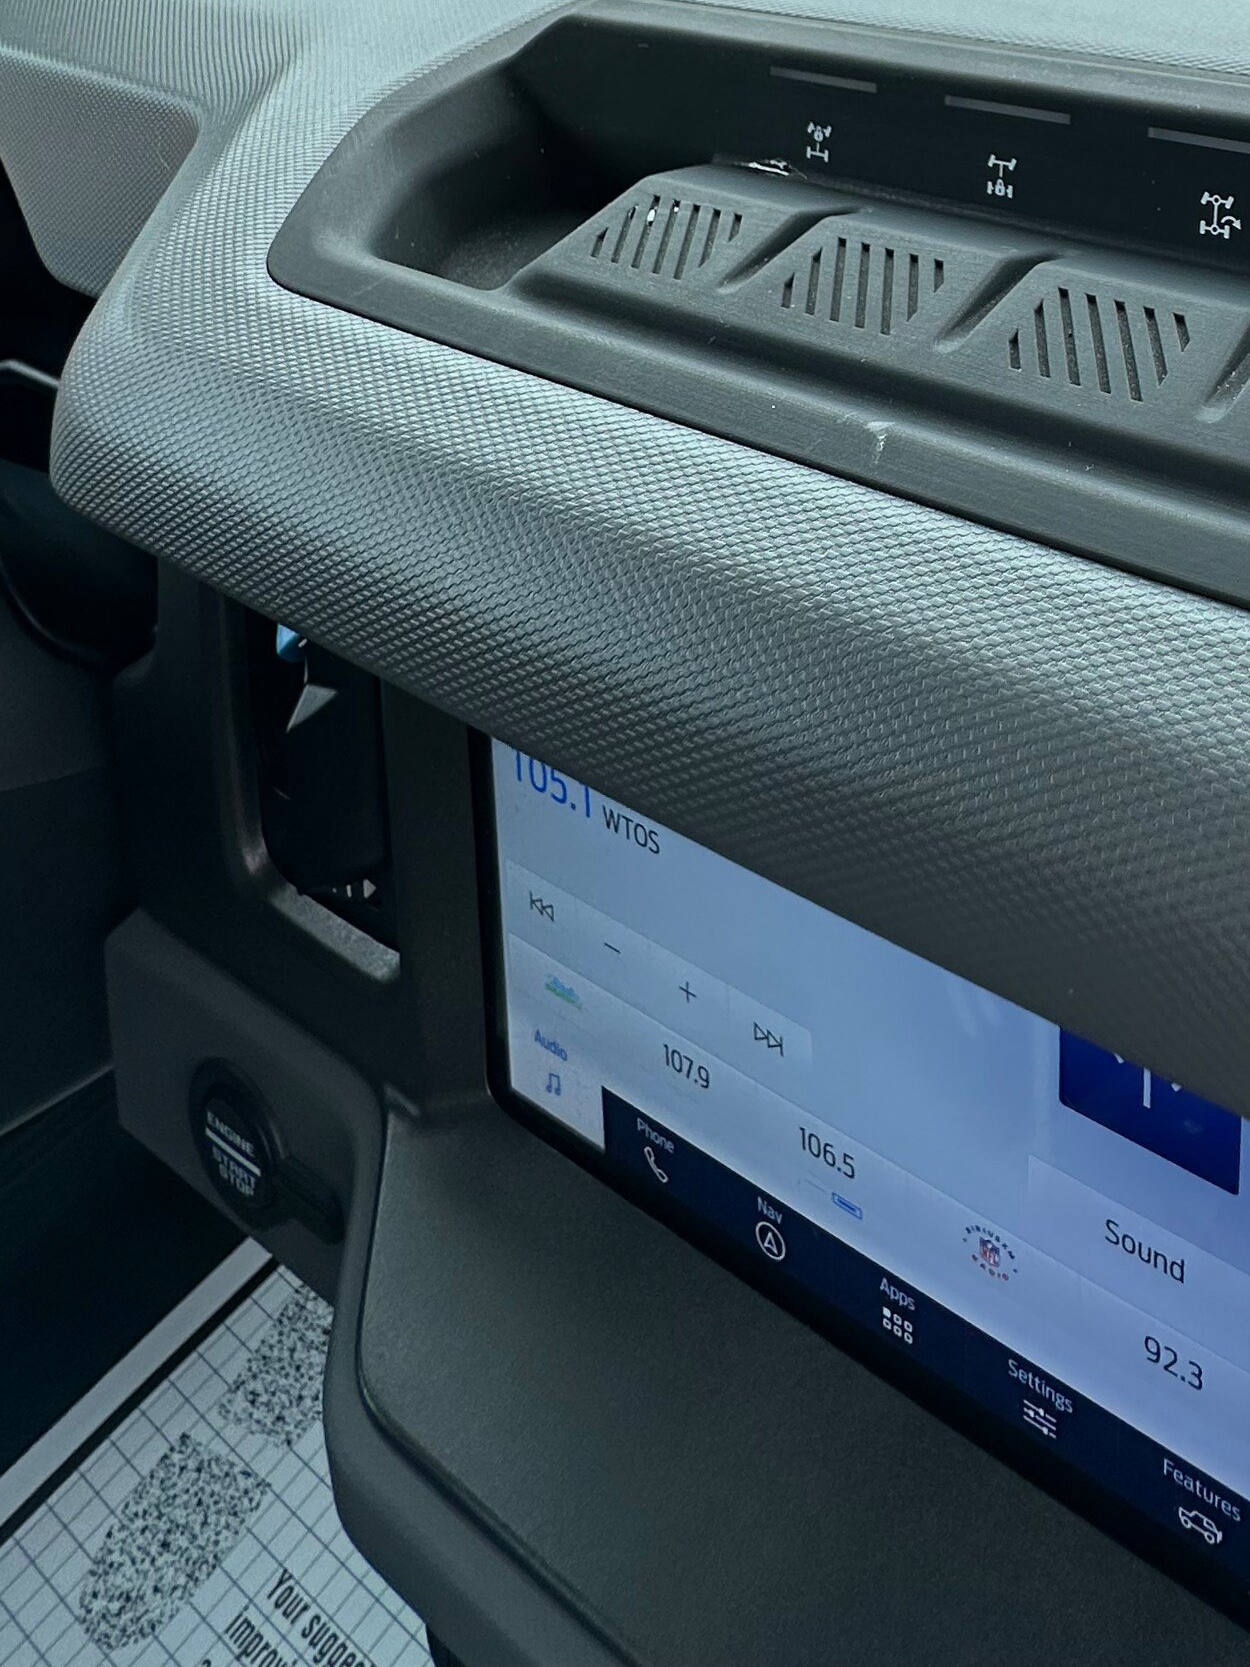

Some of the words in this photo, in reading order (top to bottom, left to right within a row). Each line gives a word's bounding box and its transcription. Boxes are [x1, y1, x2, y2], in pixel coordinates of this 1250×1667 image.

[515, 749, 591, 818] 105.1
[602, 804, 660, 854] WTOS
[534, 1029, 568, 1062] Audio
[663, 1043, 710, 1089] 107.9
[637, 1117, 675, 1154] Phone
[799, 1126, 855, 1179] 106.5
[756, 1196, 783, 1224] Nav
[1104, 1218, 1185, 1284] Sound
[880, 1277, 915, 1311] Apps
[1008, 1358, 1073, 1413] Settings
[1144, 1335, 1203, 1391] 92.3
[1163, 1457, 1242, 1523] Features
[267, 1568, 311, 1625] Your
[301, 1614, 377, 1667] sugge
